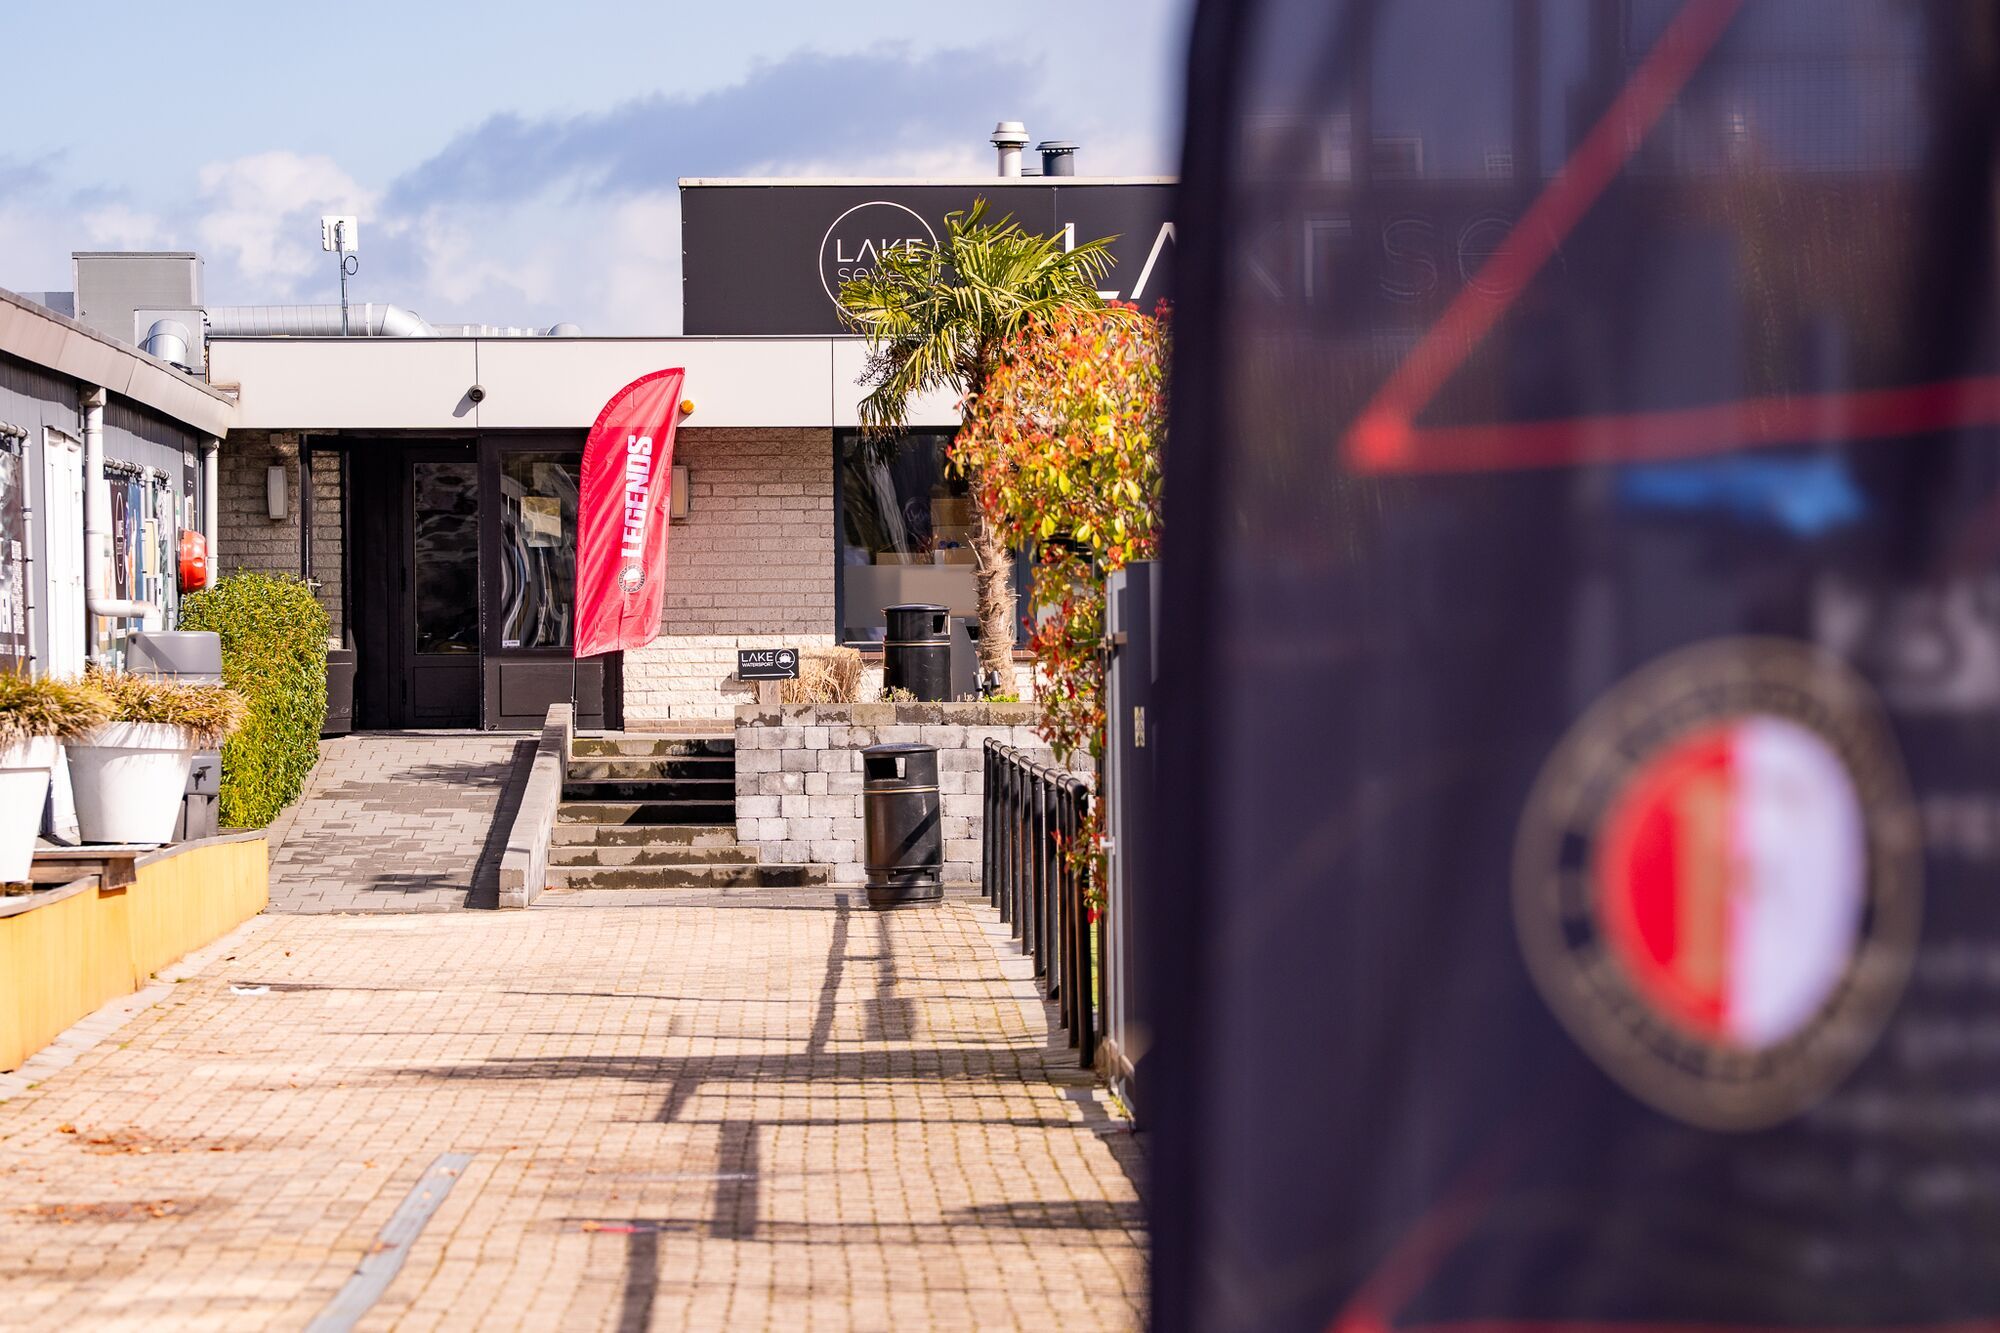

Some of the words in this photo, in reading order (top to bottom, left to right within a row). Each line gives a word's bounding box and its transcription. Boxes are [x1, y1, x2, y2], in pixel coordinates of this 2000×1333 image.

[837, 238, 922, 262] LAKE
[621, 435, 652, 558] LEGENDS
[741, 652, 774, 662] LAKE
